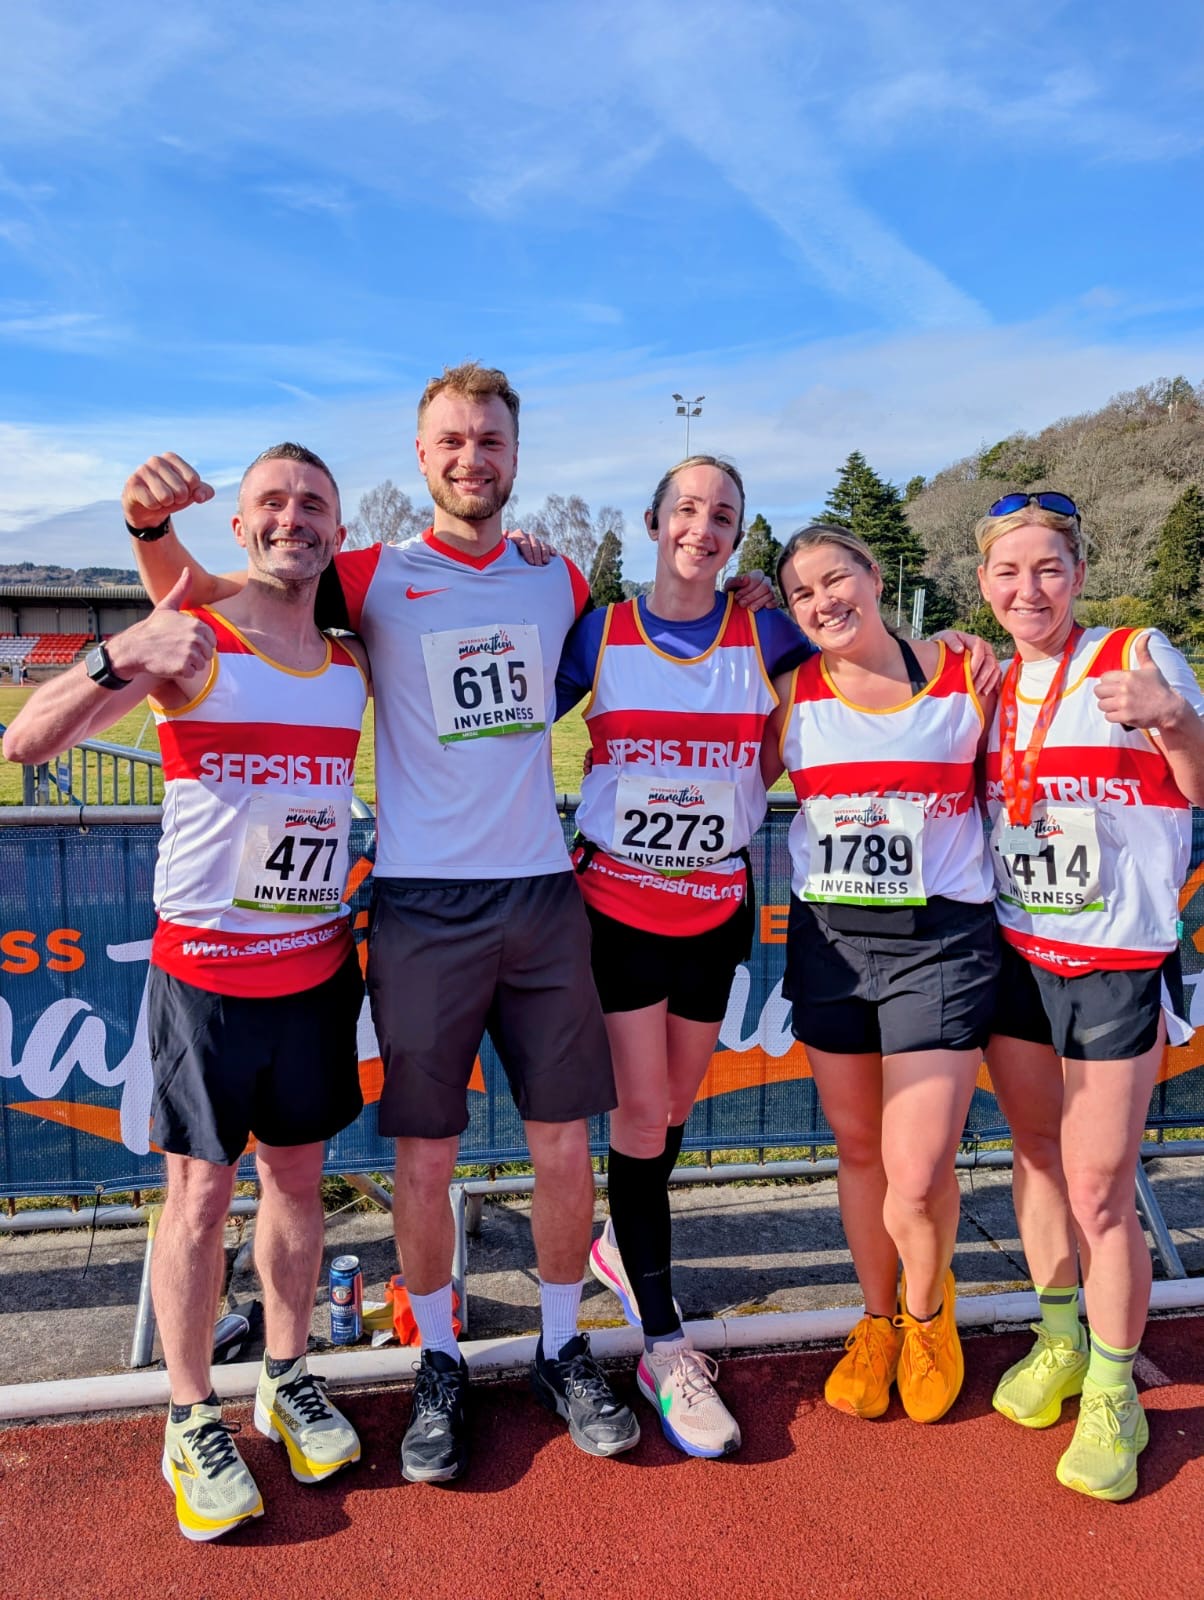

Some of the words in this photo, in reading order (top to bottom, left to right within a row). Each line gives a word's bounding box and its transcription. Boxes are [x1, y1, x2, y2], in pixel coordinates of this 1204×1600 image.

[453, 661, 528, 709] 615
[454, 707, 534, 730] INVERNESS
[199, 752, 312, 785] SEPSIS
[648, 787, 704, 805] marathon
[1037, 777, 1141, 806] TRUST
[834, 807, 887, 827] marathon
[621, 809, 725, 852] 2273
[265, 835, 339, 882] 477
[628, 852, 715, 868] INVERNESS
[818, 834, 913, 876] 1789
[254, 885, 339, 902] INVERNESS
[820, 879, 909, 895] INVERNESS
